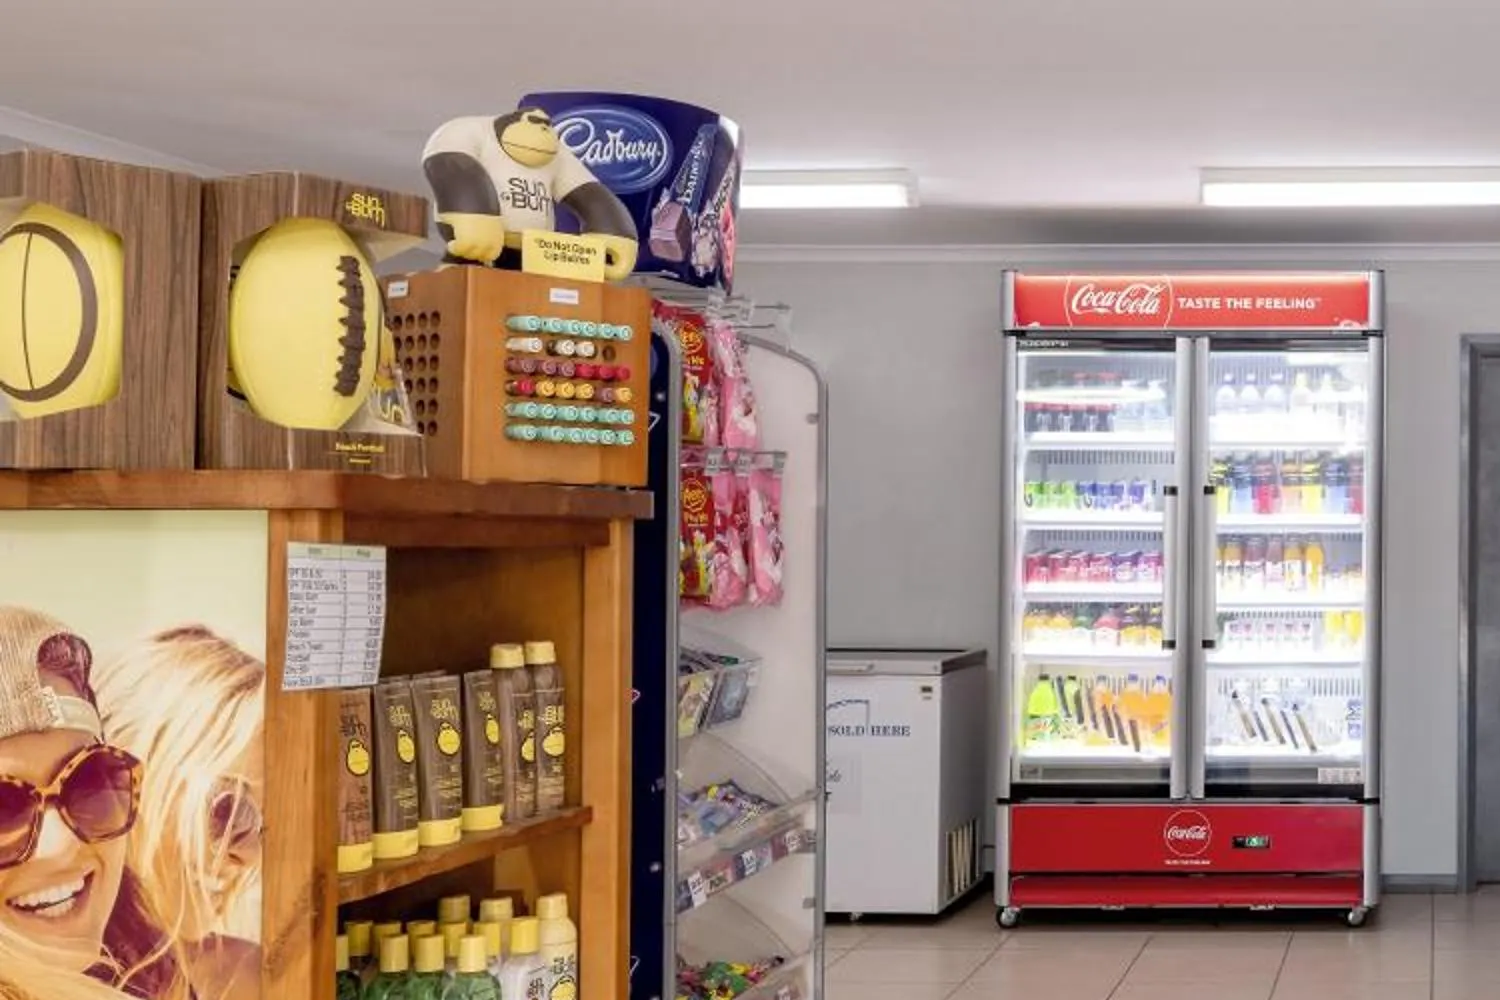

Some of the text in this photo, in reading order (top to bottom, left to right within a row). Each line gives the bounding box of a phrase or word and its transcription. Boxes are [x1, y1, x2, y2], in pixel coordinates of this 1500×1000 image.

[553, 117, 661, 169] Cadbury
[554, 241, 571, 251] Not
[571, 243, 597, 255] Open
[1071, 283, 1316, 316] Coca-Cola TASTE THE FEELING
[829, 725, 911, 737] SOLD HERE
